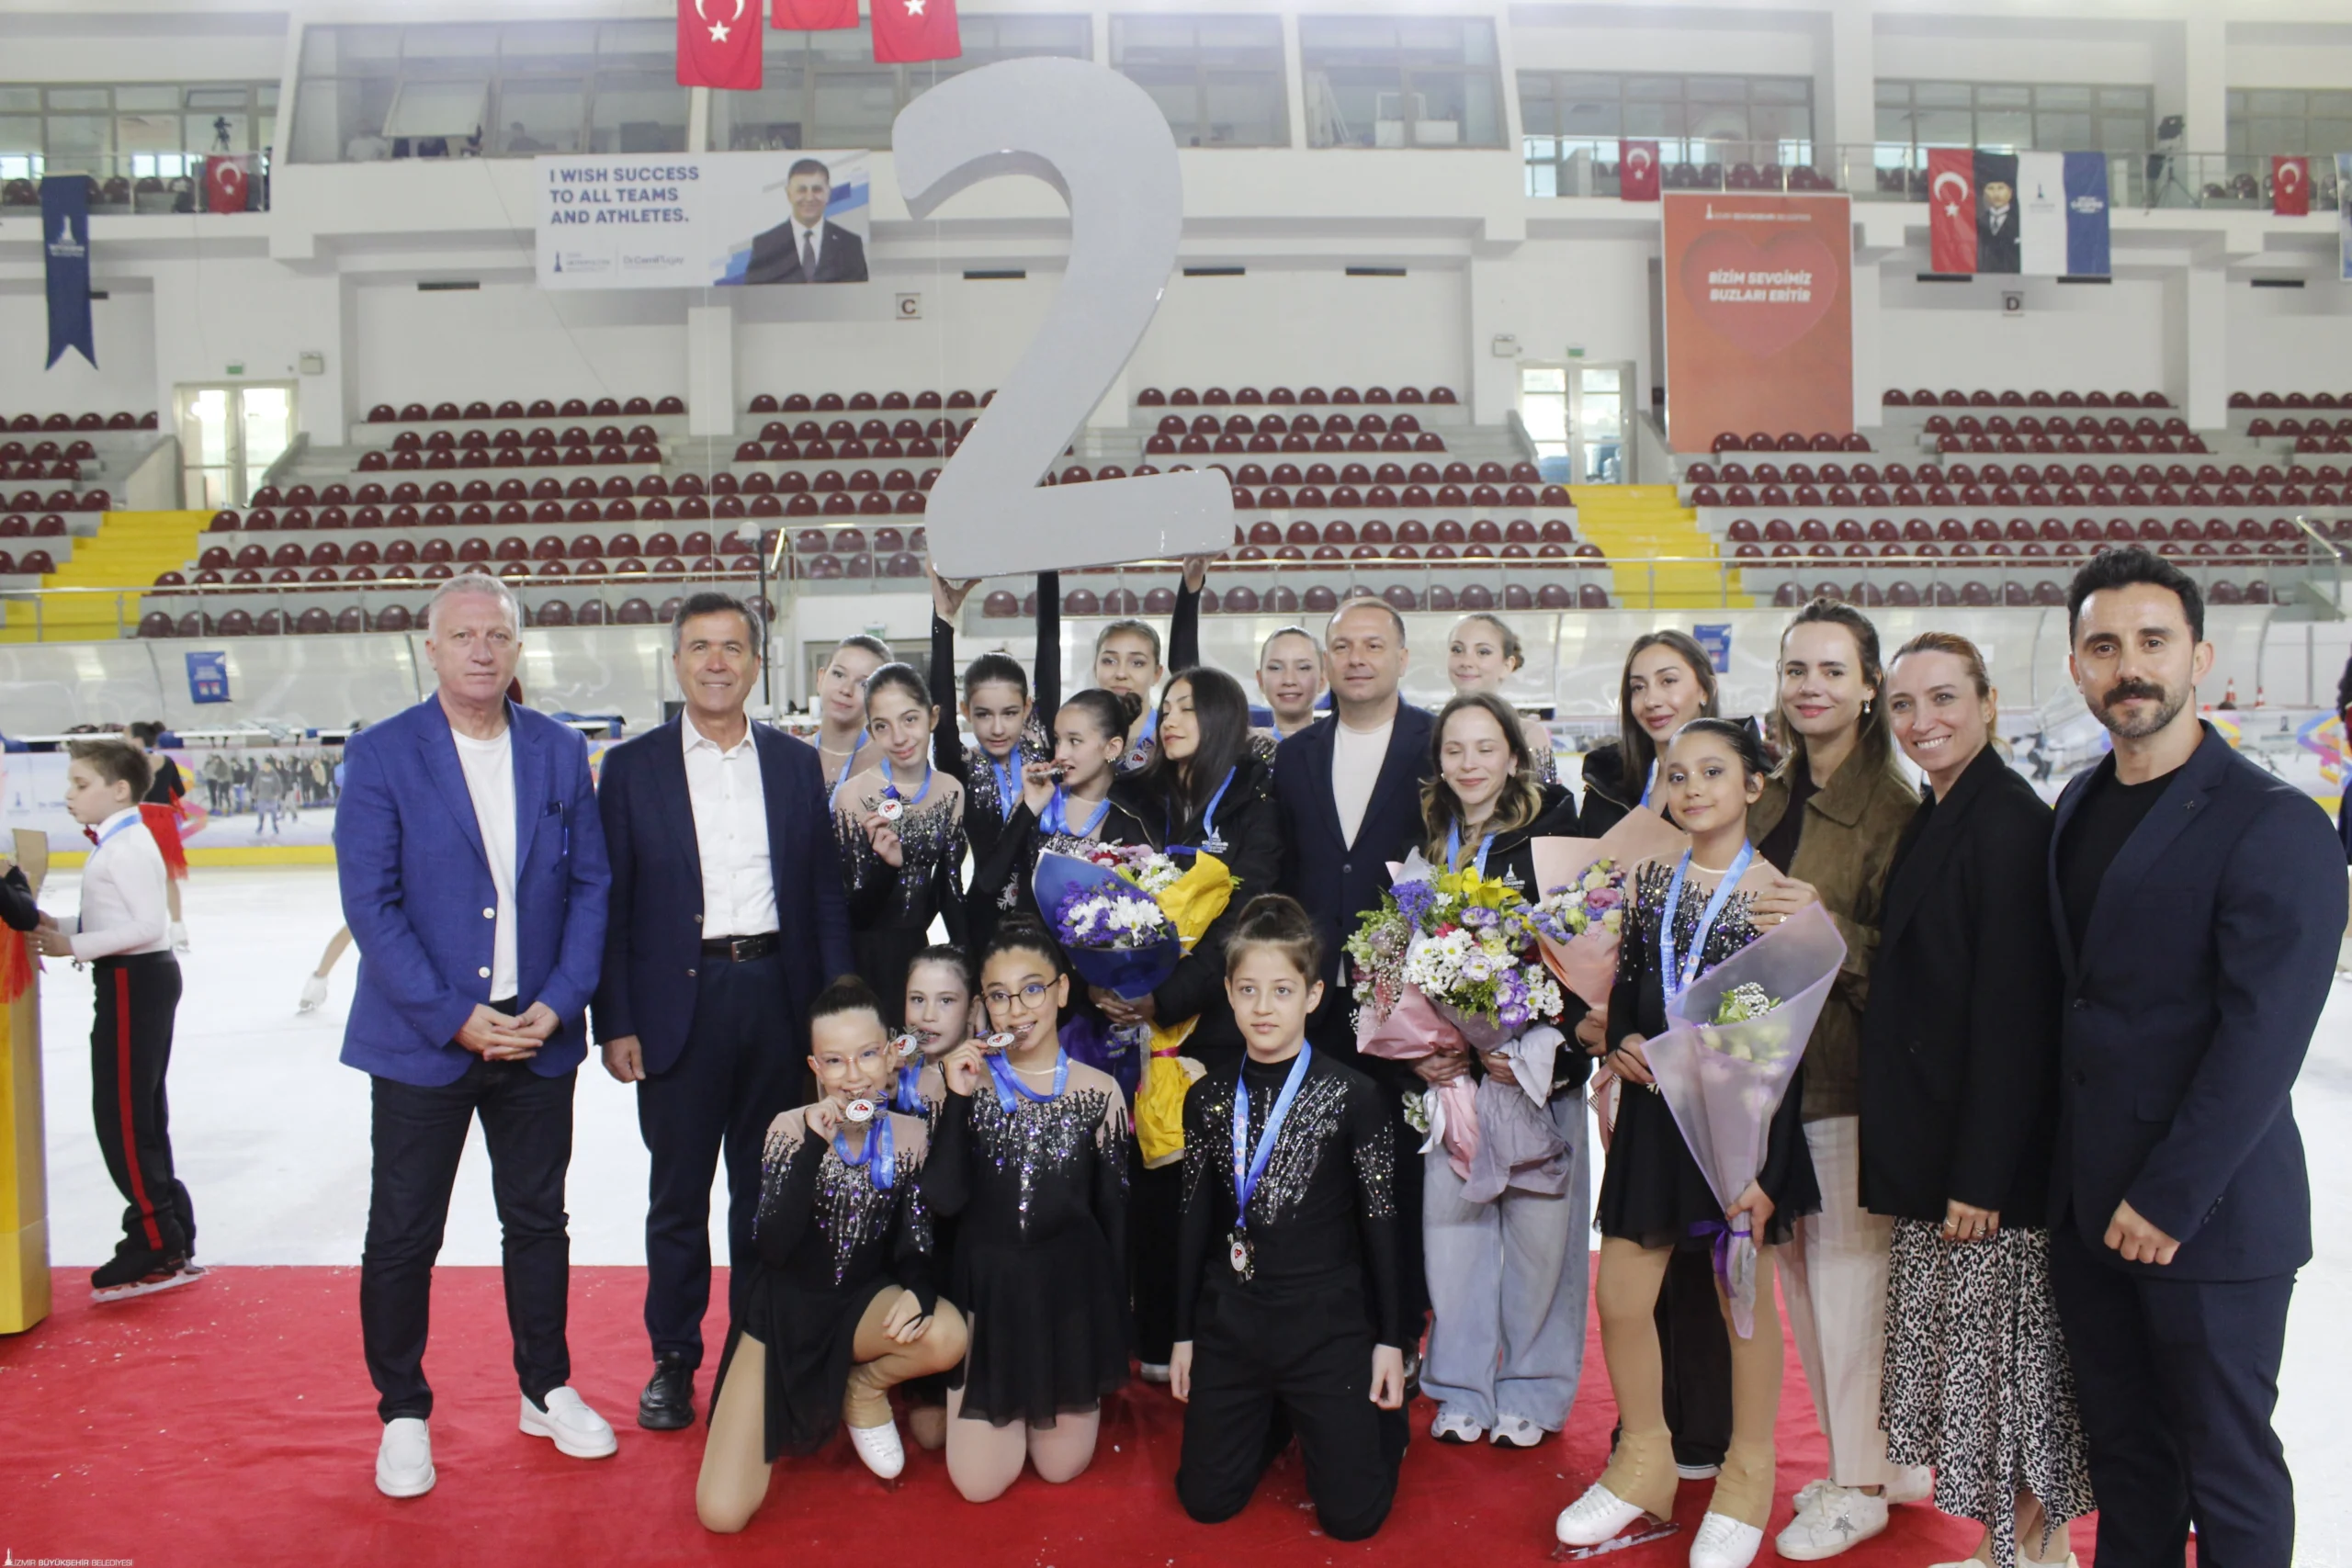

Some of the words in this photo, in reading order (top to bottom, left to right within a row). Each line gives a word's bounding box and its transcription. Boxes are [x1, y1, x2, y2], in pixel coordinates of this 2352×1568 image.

[549, 169, 555, 183] I
[560, 168, 607, 183] WISH
[614, 166, 699, 182] SUCCESS
[549, 189, 573, 203] TO
[579, 188, 612, 203] ALL
[616, 187, 679, 202] TEAMS
[550, 209, 590, 224] AND
[595, 208, 690, 223] ATHLETES.
[901, 299, 916, 315] C
[2006, 296, 2019, 311] D
[891, 57, 1236, 581] 2
